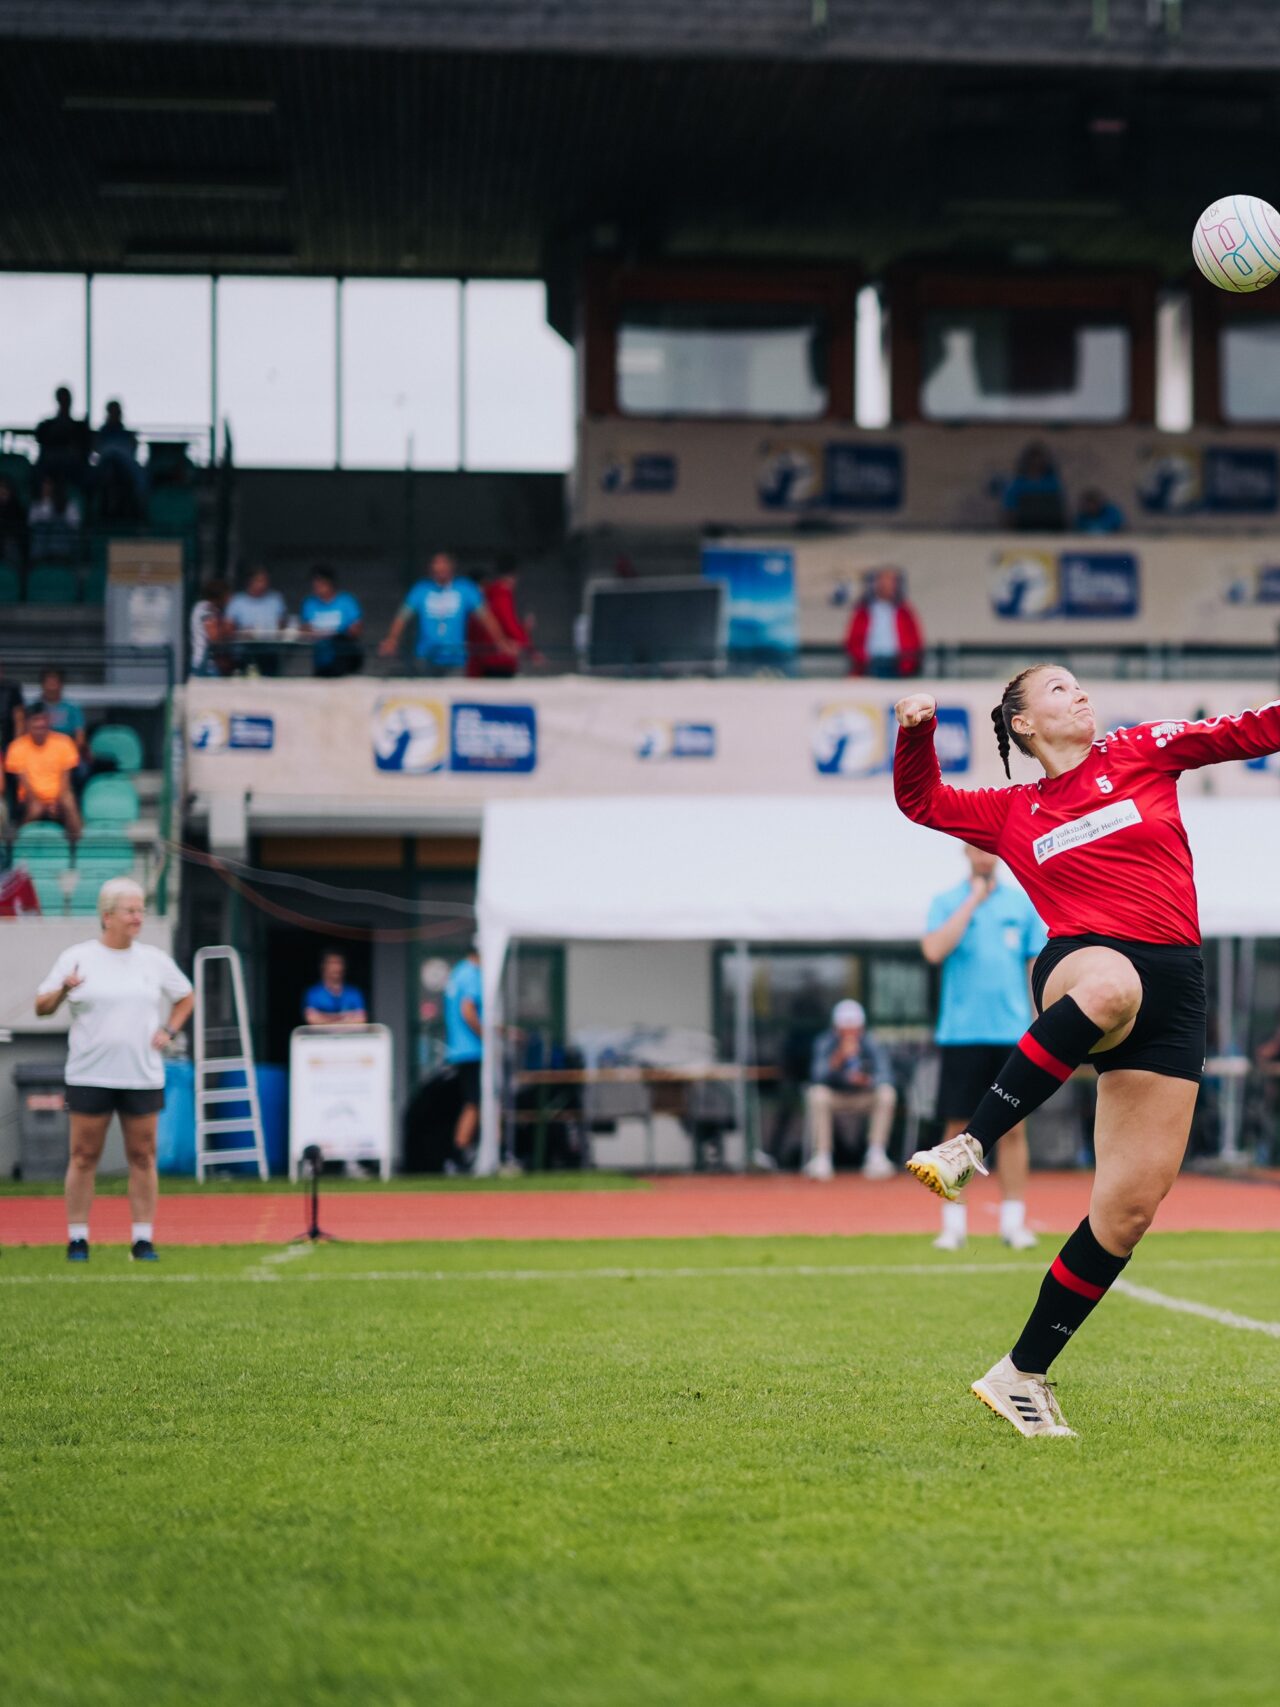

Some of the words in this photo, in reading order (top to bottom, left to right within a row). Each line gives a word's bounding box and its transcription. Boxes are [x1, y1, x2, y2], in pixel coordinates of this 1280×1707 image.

[1095, 775, 1114, 794] 5
[1055, 820, 1092, 839] Volksbank
[1057, 828, 1100, 848] Lüneburger
[1100, 817, 1123, 831] Heide
